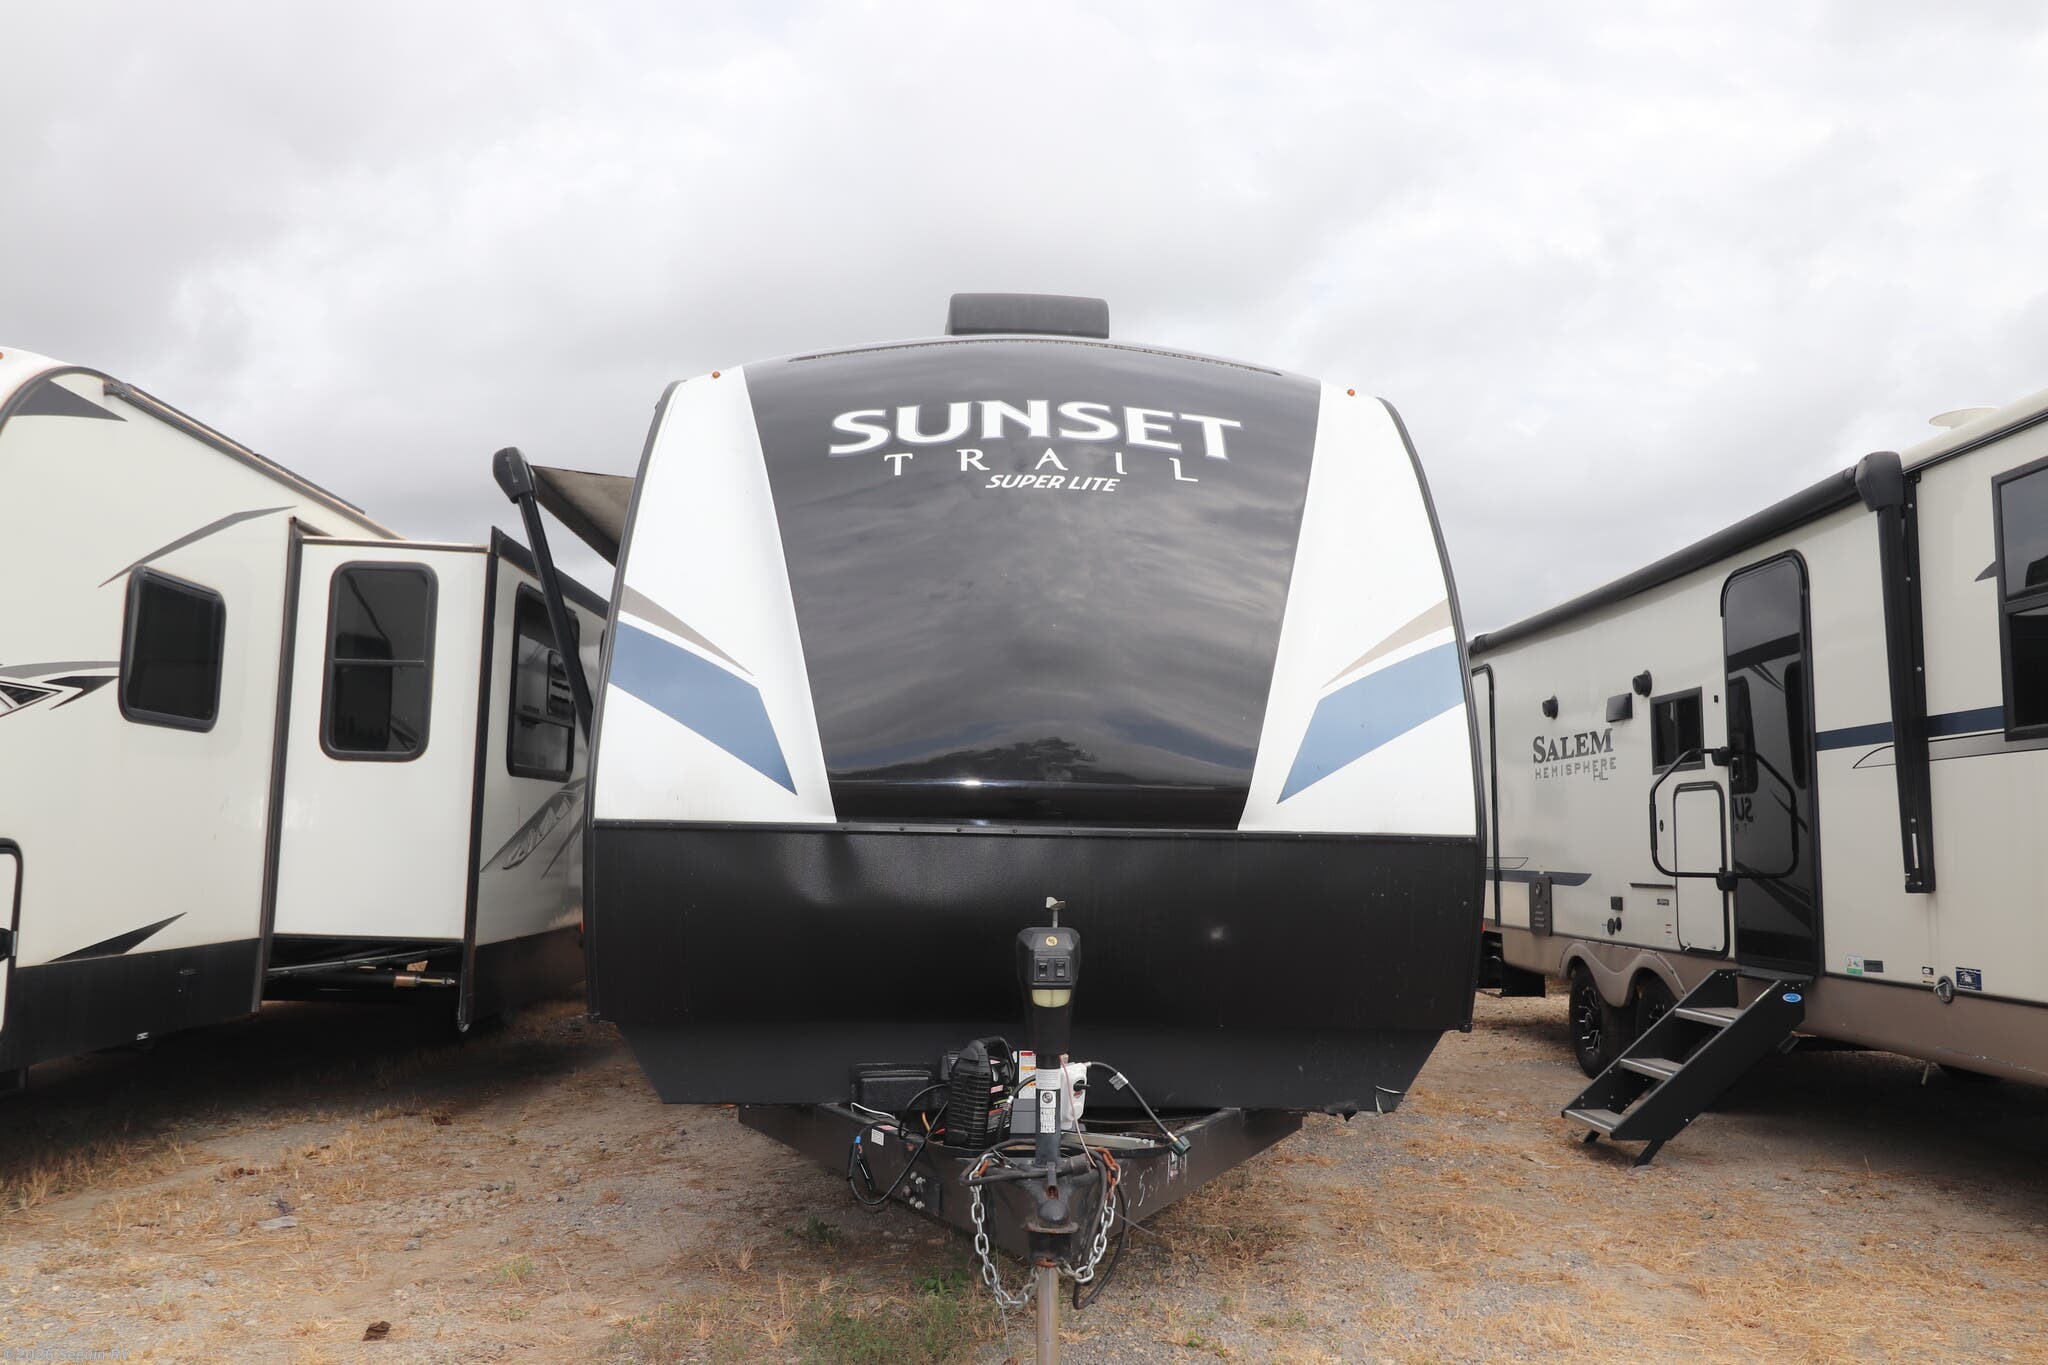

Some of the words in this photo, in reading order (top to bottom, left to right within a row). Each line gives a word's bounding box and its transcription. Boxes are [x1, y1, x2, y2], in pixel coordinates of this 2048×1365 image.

[828, 400, 1243, 461] SUNSET
[884, 447, 1199, 483] TRAIL
[985, 474, 1066, 489] SUPER
[1067, 476, 1121, 492] LITE
[1534, 757, 1617, 780] HEMISPHERE
